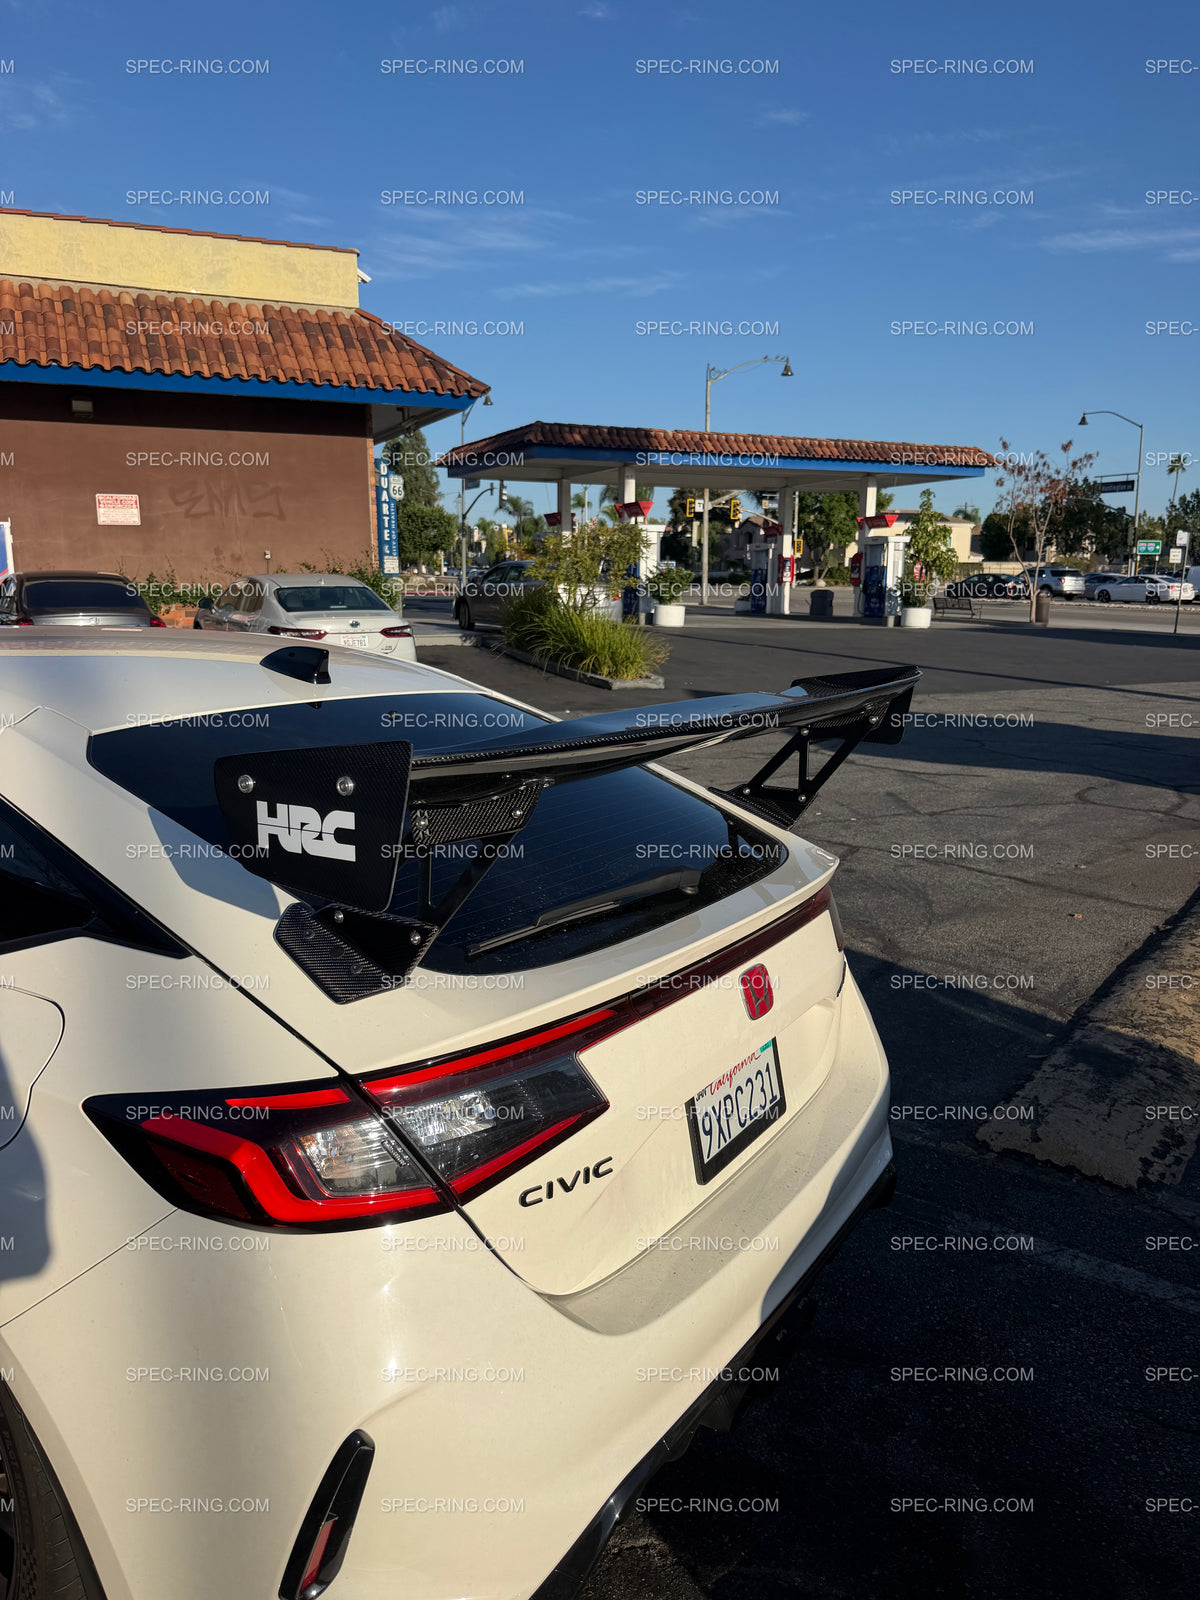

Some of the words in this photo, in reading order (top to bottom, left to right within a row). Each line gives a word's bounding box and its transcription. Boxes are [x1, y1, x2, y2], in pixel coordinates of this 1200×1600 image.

[380, 463, 391, 541] DUARTE
[392, 485, 403, 496] 66
[256, 800, 356, 863] HRC
[701, 1061, 779, 1160] 9XPC231
[518, 1155, 614, 1208] CIVIC
